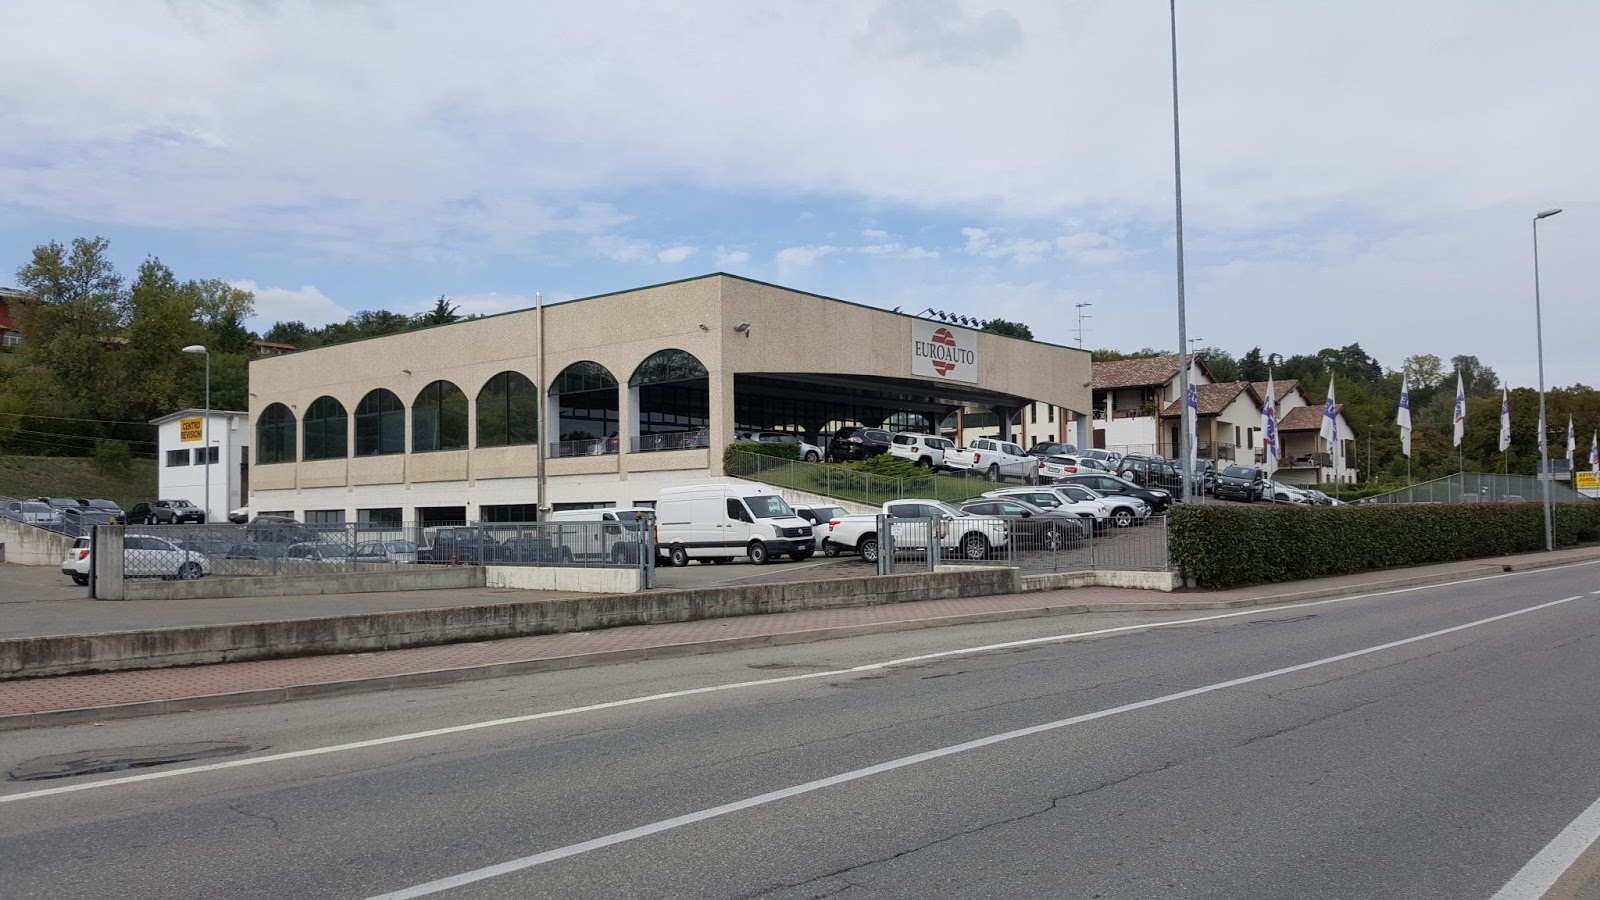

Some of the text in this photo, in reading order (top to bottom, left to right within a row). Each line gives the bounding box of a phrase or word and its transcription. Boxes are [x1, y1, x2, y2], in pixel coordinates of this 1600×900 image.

[915, 341, 974, 365] EUROAUTO
[183, 421, 200, 430] CENTRO
[181, 431, 202, 439] REVISIONI
